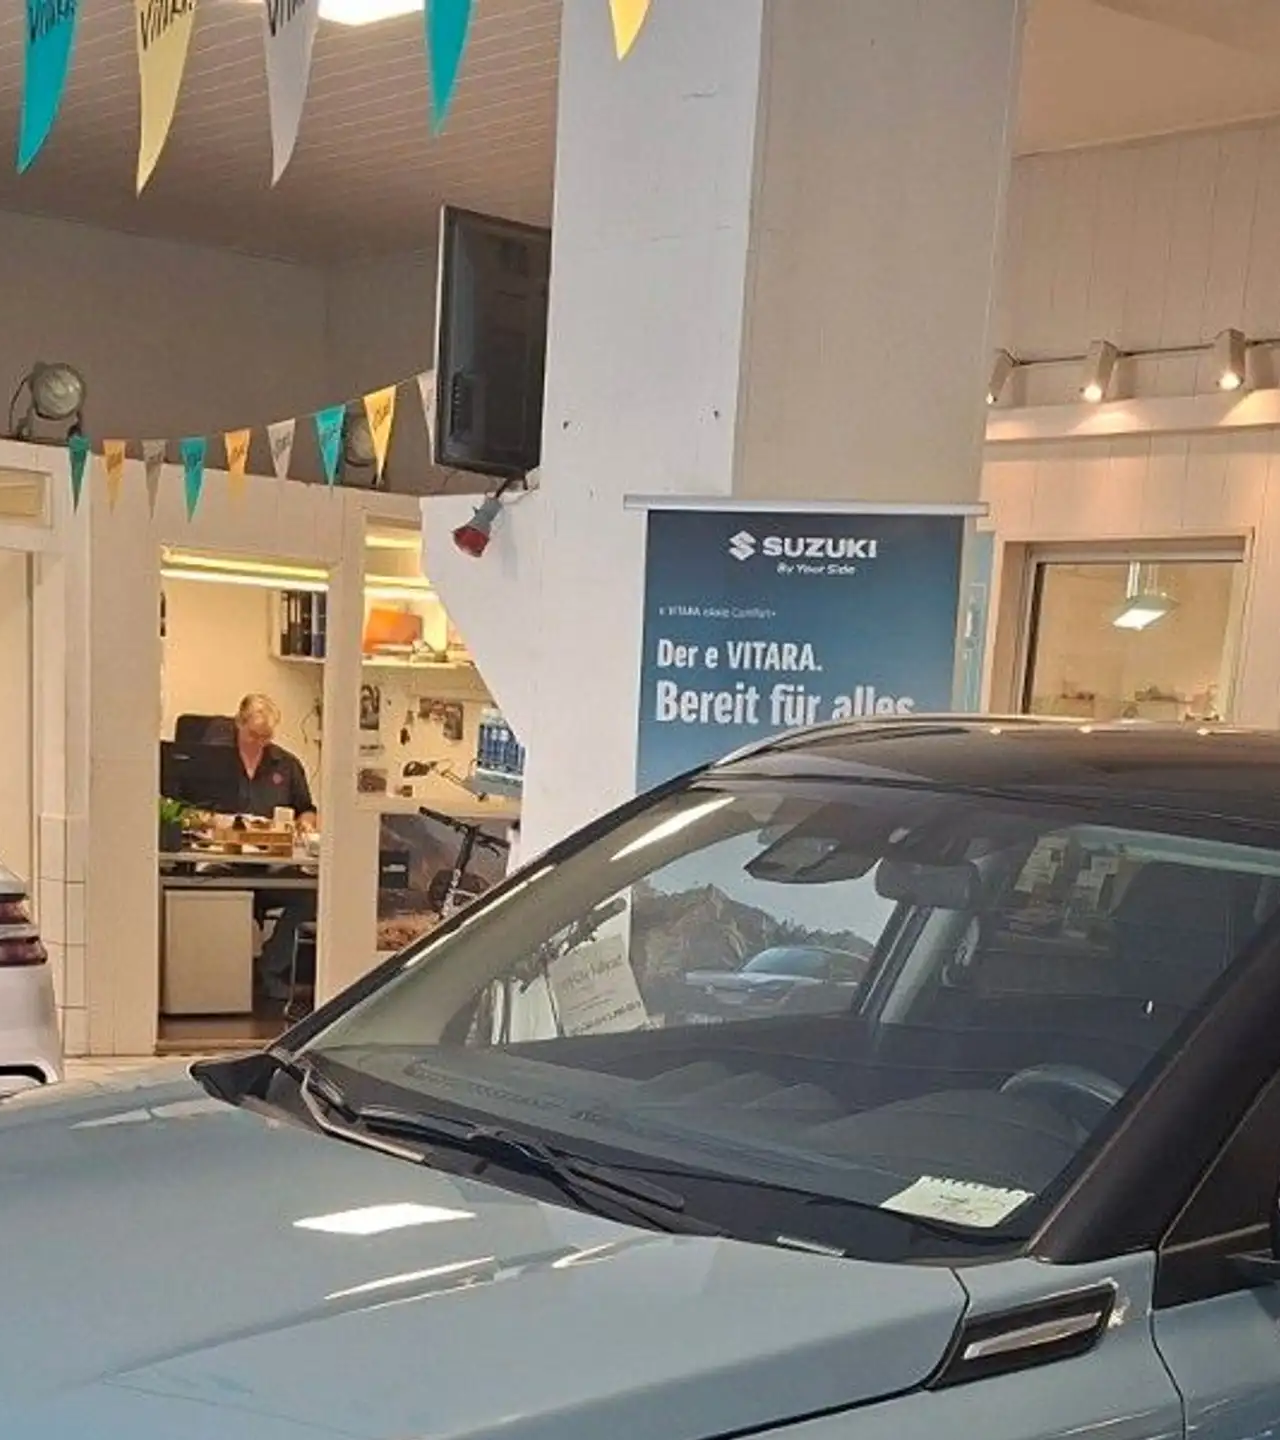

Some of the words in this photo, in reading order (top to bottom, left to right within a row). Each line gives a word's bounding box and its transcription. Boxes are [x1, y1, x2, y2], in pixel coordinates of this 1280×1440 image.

[762, 536, 877, 559] SUZUKI
[655, 638, 698, 669] Der
[704, 645, 719, 669] e
[726, 640, 823, 672] VITARA.
[655, 679, 761, 724] Bereit
[769, 682, 822, 727] für
